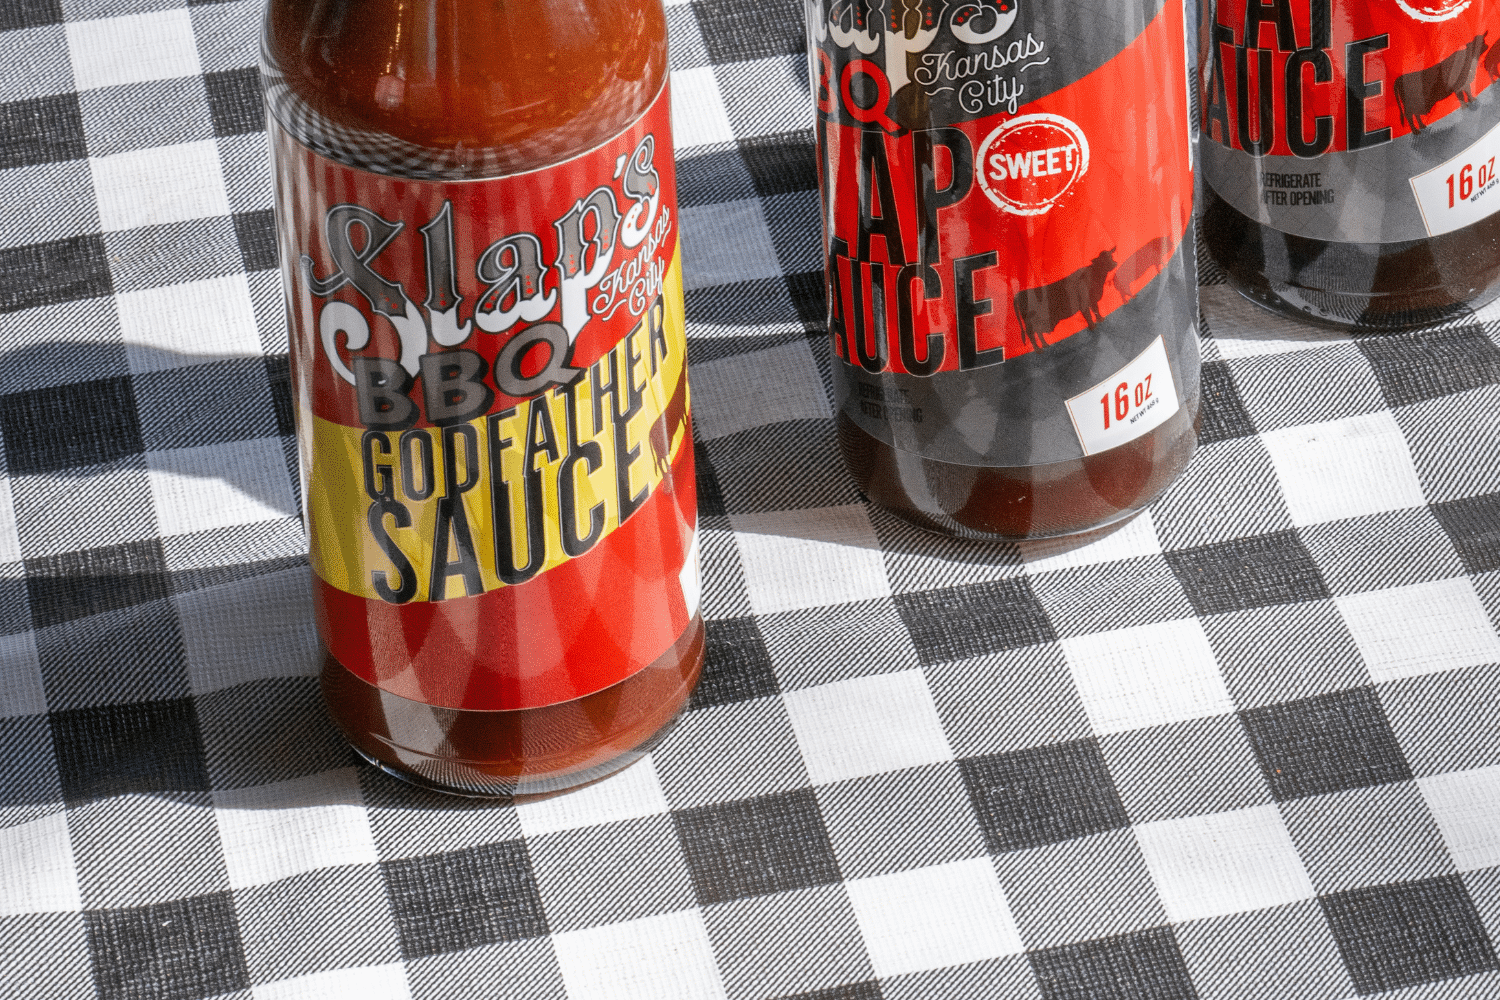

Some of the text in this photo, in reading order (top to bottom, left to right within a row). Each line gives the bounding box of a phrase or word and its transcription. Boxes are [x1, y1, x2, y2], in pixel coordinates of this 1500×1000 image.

[816, 47, 909, 138] BQ
[913, 32, 1045, 86] Kansas
[957, 74, 1025, 115] City
[1206, 34, 1393, 159] AUCE
[817, 120, 976, 265] LAP
[988, 144, 1077, 180] SWEET
[1289, 188, 1335, 206] OPENING
[1446, 155, 1496, 209] 16 OZ
[301, 133, 661, 385] Slap's
[592, 205, 670, 314] Kansas
[629, 256, 666, 317] City
[830, 250, 1006, 378] AUCE
[352, 321, 588, 430] BBQ
[361, 296, 668, 501] GODFATHER
[1100, 372, 1153, 430] 16 OZ
[367, 413, 651, 605] SAUCE
